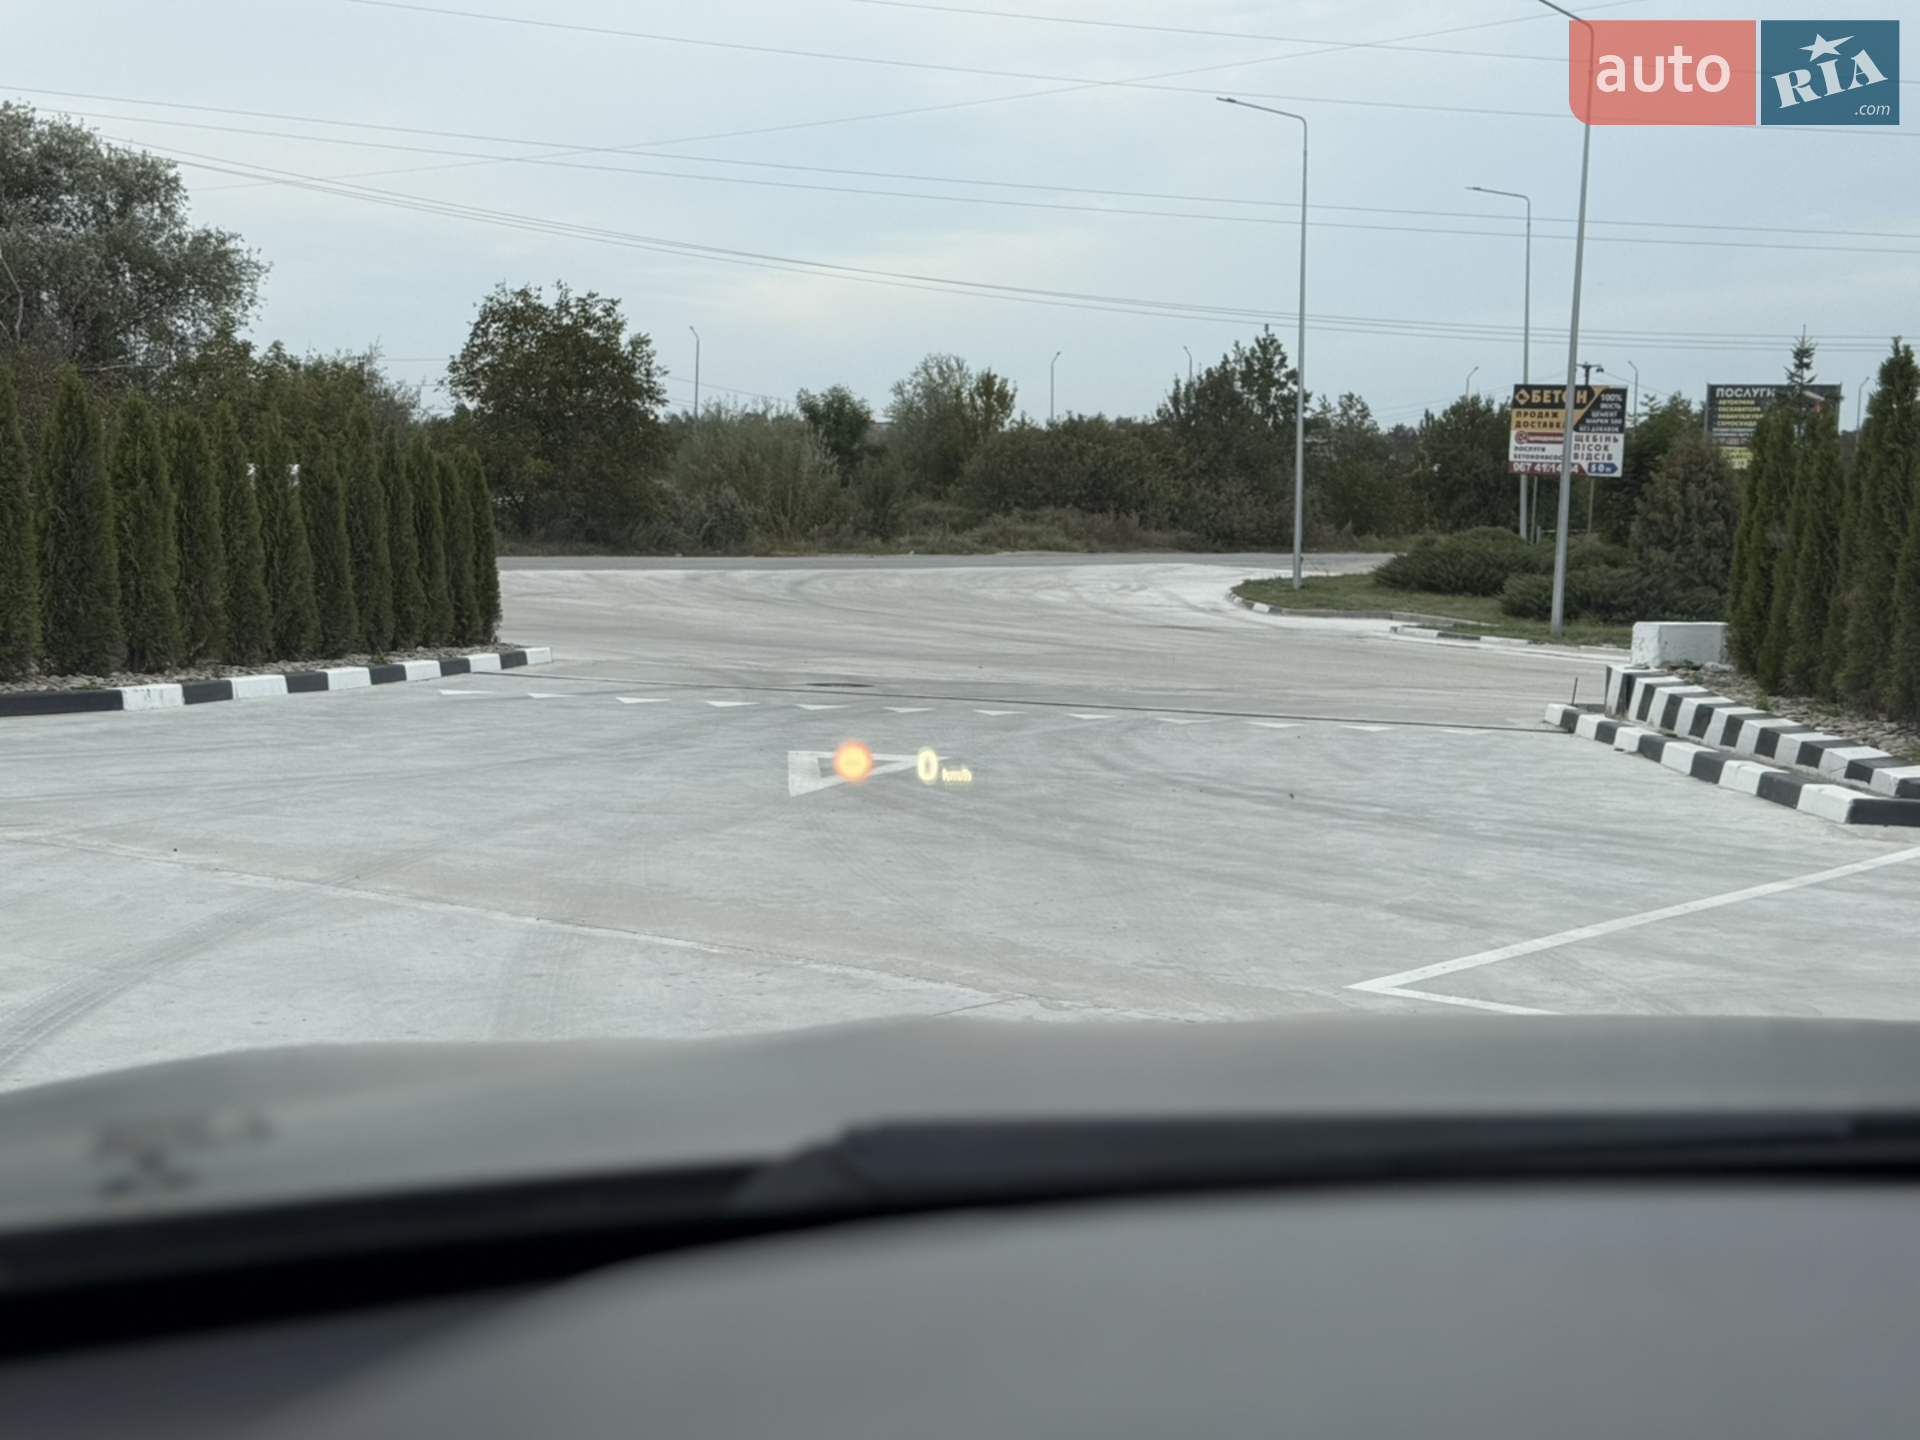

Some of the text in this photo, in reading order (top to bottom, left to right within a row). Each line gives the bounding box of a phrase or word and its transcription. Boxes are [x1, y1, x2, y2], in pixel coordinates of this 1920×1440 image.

[1716, 387, 1776, 398] ПОСЛУГИ
[1600, 393, 1623, 402] 100%
[1515, 411, 1559, 419] ПРОДАЖ
[1574, 434, 1619, 443] ЩЕБІНЬ
[1574, 443, 1610, 452] ПІСОК
[1573, 452, 1613, 461] ВІДСІВ
[1512, 462, 1532, 472] 067
[917, 748, 938, 782] 0
